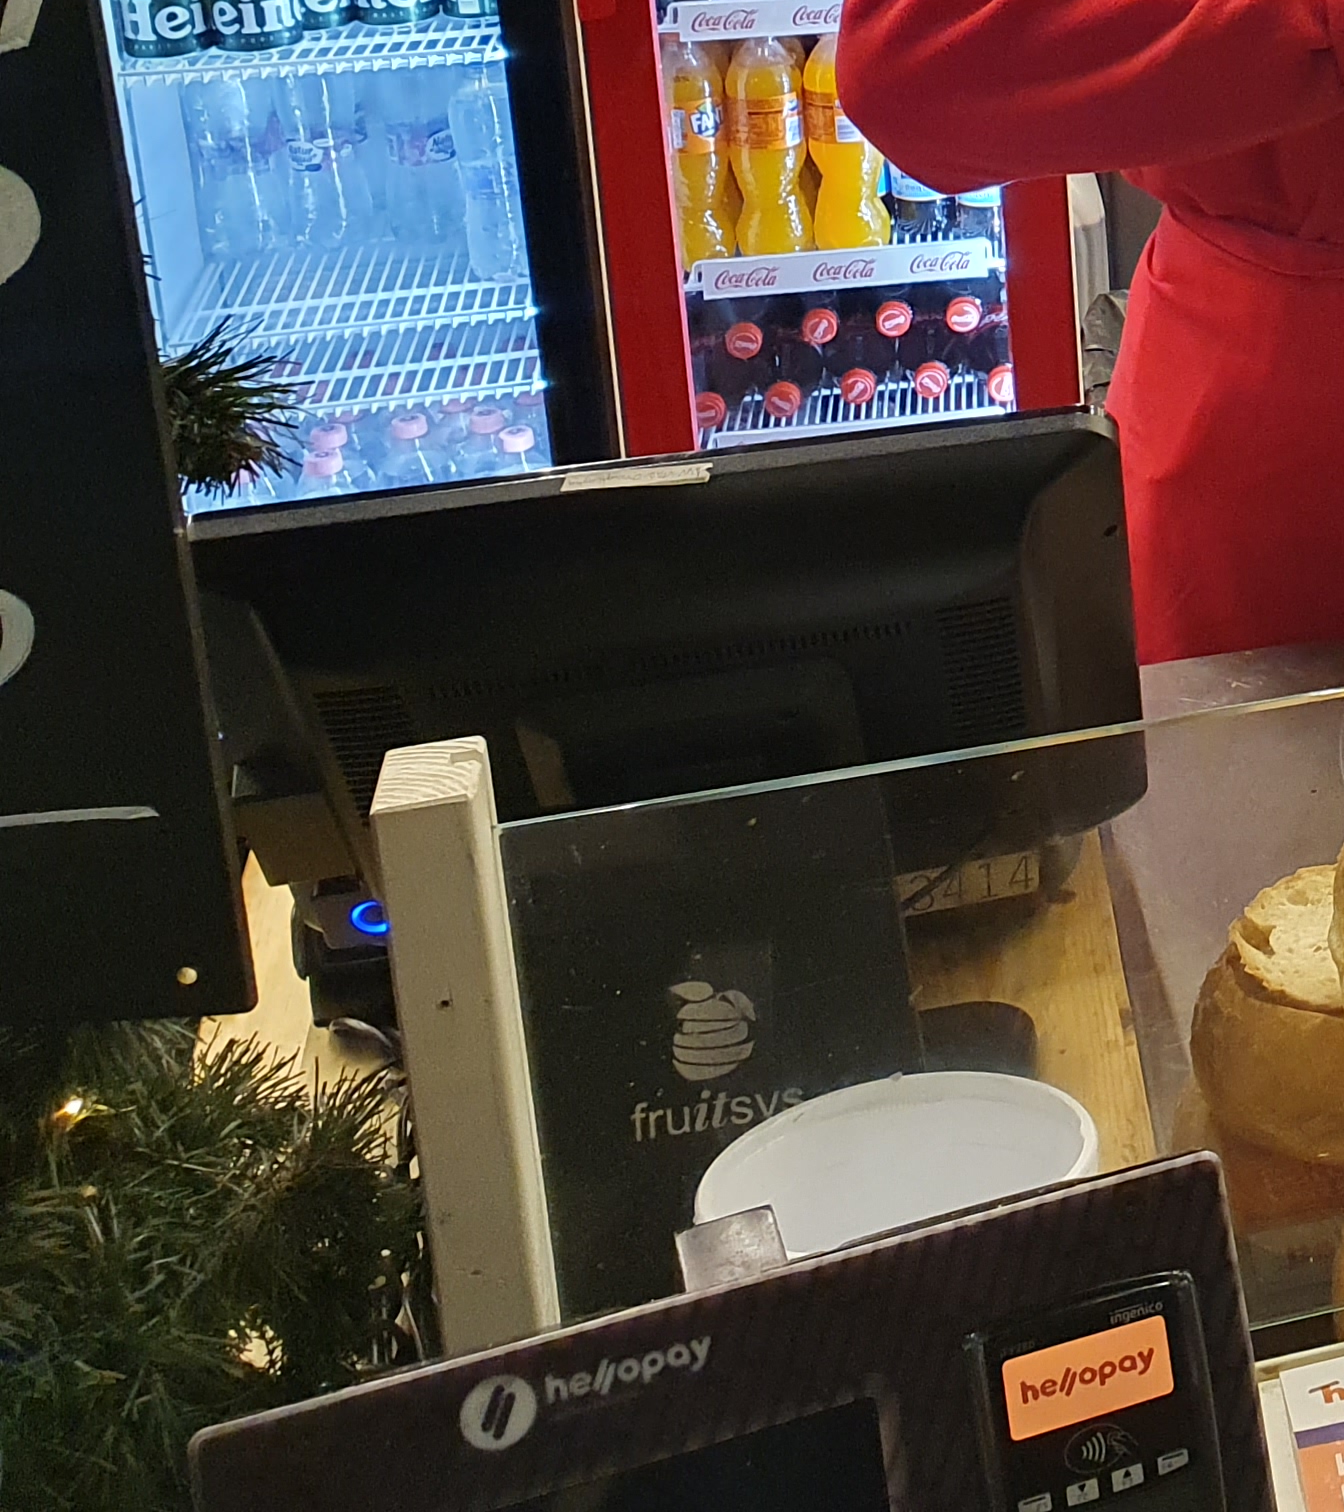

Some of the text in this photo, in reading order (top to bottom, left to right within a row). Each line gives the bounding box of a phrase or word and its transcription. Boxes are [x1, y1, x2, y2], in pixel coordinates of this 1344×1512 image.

[691, 9, 759, 34] Coca-Cola
[714, 251, 972, 290] Coca-Cola Coca-Cola Coca-Cola
[1109, 1300, 1164, 1326] ingenico
[544, 1335, 712, 1405] hellopay
[1019, 1347, 1155, 1405] hellopay
